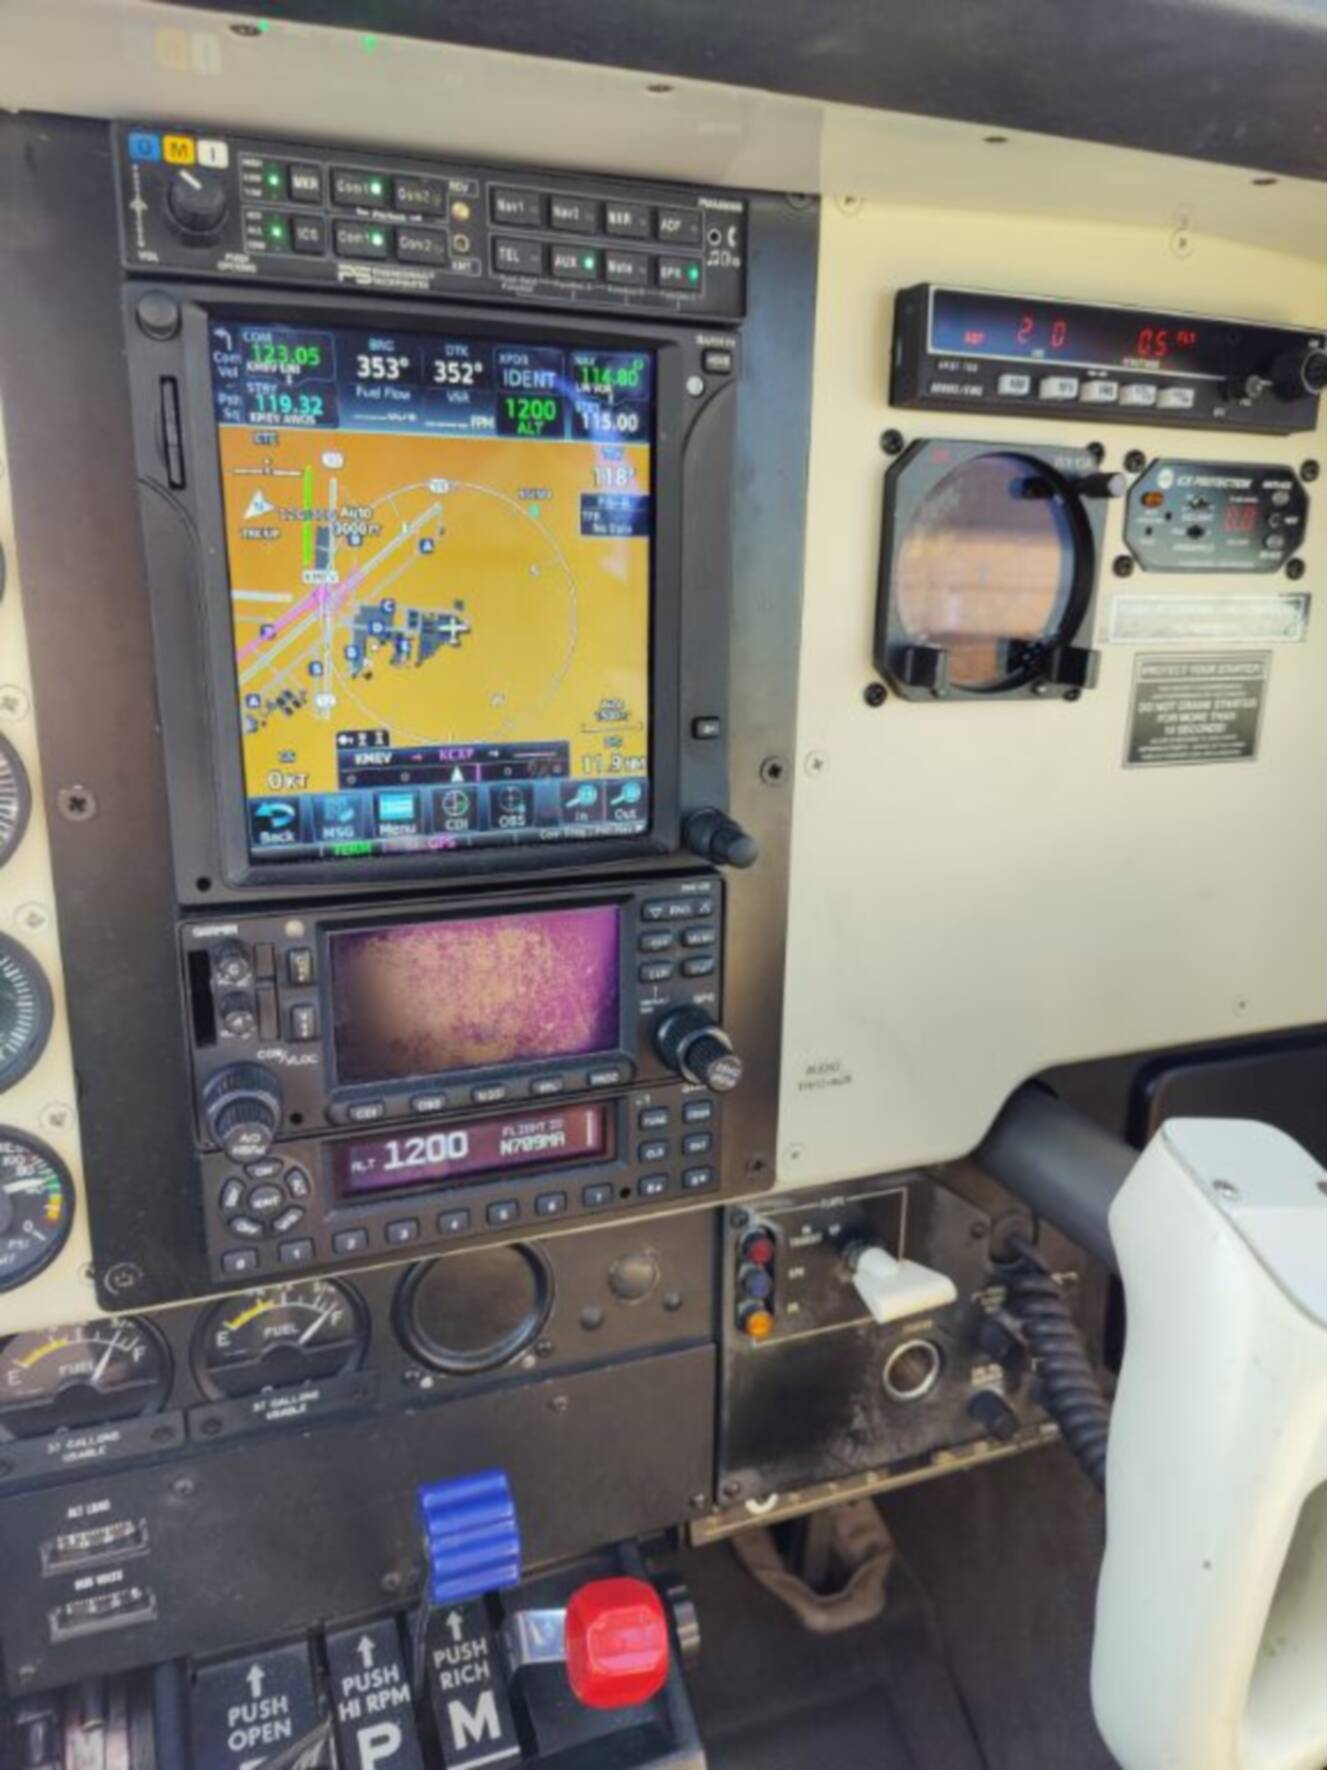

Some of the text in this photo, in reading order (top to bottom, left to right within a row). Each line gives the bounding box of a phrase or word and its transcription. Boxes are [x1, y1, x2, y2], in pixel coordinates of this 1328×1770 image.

[554, 254, 577, 268] AUX
[252, 344, 321, 366] 123.05
[503, 368, 556, 388] IDENT
[255, 394, 324, 416] 119.32
[506, 398, 557, 420] 1200
[517, 421, 545, 435] ALT
[582, 411, 639, 432] 115.00
[498, 813, 527, 828] OBS
[383, 1130, 470, 1171] 1200
[330, 1309, 344, 1327] F
[216, 1330, 232, 1349] E
[263, 1322, 299, 1338] FUEL
[132, 1346, 146, 1363] F
[7, 1369, 22, 1387] E
[433, 1637, 488, 1668] PUSH
[341, 1663, 400, 1697] PUSH
[439, 1661, 491, 1691] RICH
[226, 1695, 289, 1728] PUSH
[337, 1683, 411, 1722] HI RPM
[447, 1690, 503, 1751] M
[226, 1718, 292, 1752] OPEN
[356, 1721, 403, 1770] P
